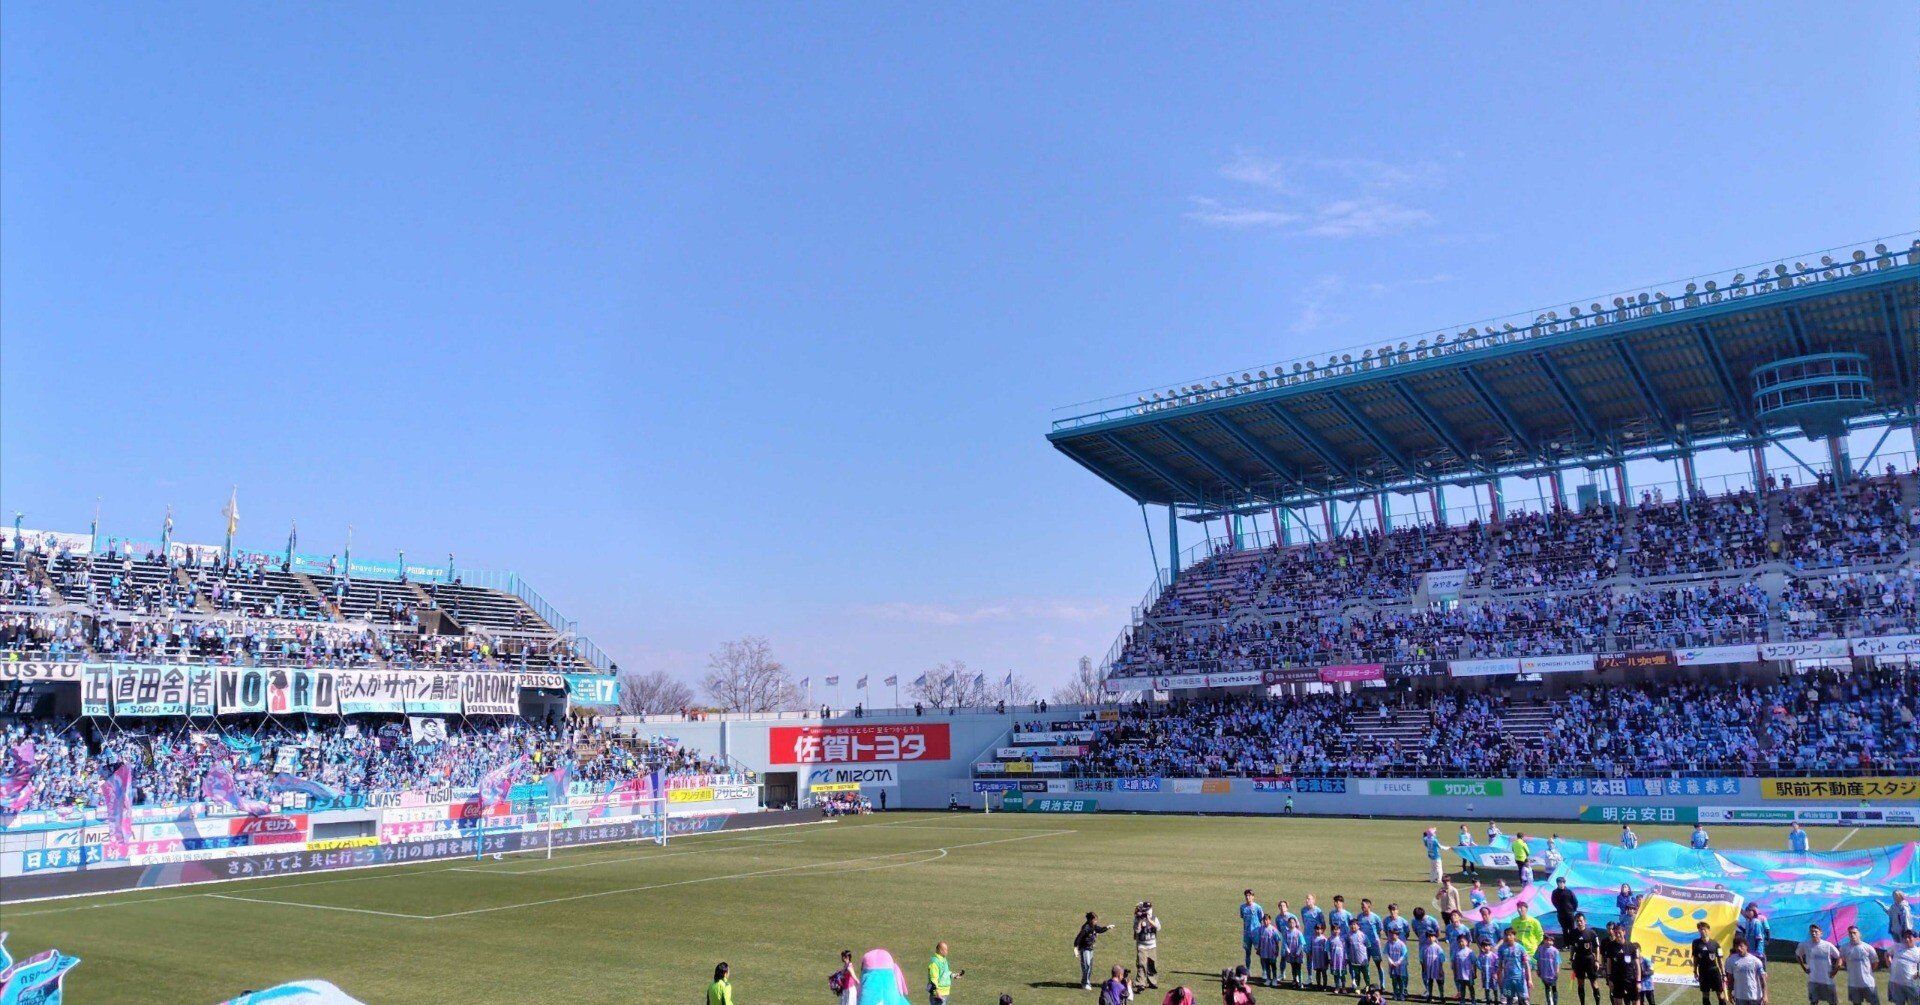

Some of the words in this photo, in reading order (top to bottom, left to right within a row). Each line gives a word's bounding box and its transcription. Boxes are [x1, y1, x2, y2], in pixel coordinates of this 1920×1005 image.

[1767, 645, 1822, 655] サニクリーン
[84, 667, 211, 705] 正直田舎者
[520, 675, 562, 686] PRISCO
[464, 674, 515, 704] CAFONE
[596, 679, 615, 702] 17
[467, 705, 514, 713] FOOTBALL
[794, 734, 926, 762] 佐賀トヨタ
[836, 769, 892, 782] MIZOTA
[715, 788, 754, 799] アサヒビール
[1384, 783, 1411, 792] FELICE
[1445, 782, 1486, 795] サロンパス
[1775, 781, 1916, 797] 駅前不動産スタジ
[1040, 800, 1084, 812] 明治安田
[1603, 807, 1675, 821] 明治安田
[310, 851, 375, 867] 共に行こう
[1656, 946, 1693, 958] FAI
[1651, 956, 1695, 968] PLA
